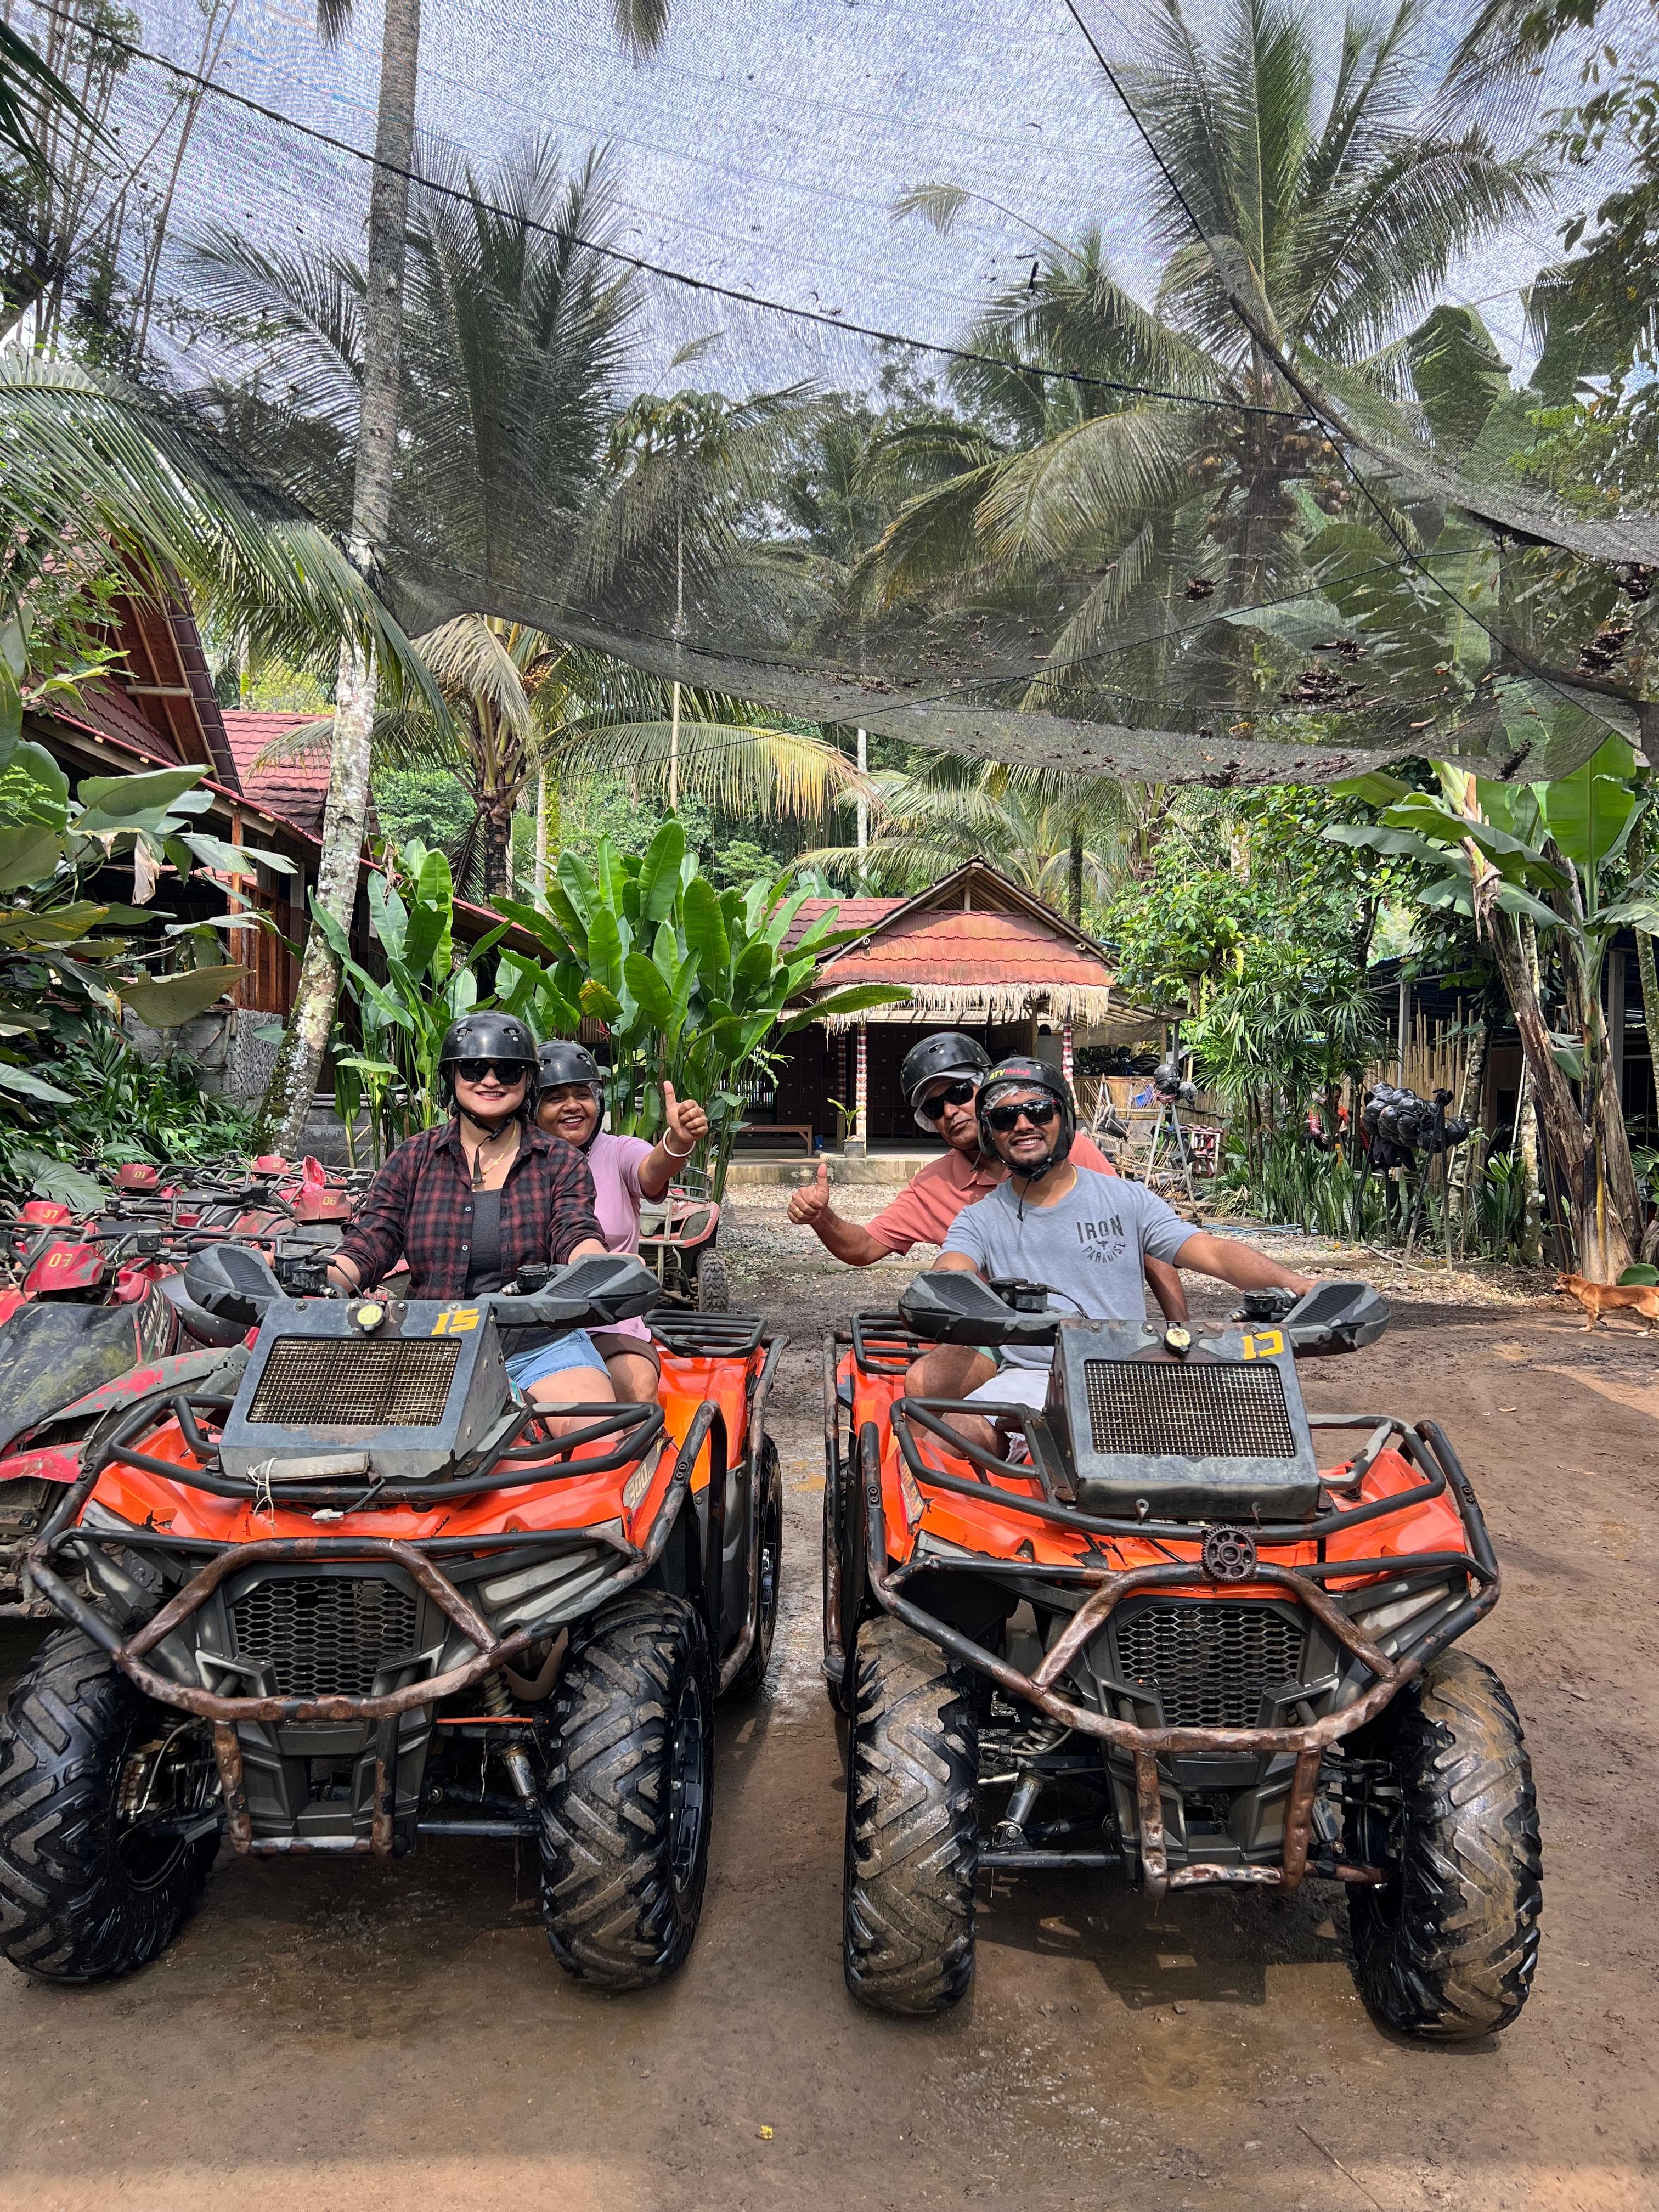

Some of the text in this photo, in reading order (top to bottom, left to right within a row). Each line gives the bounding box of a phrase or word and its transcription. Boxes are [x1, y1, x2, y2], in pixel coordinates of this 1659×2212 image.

[323, 1196, 337, 1205] 06
[1076, 1214, 1124, 1244] IRON
[48, 1253, 72, 1267] 03
[1081, 1241, 1126, 1263] PARADISE
[431, 1308, 480, 1335] 15
